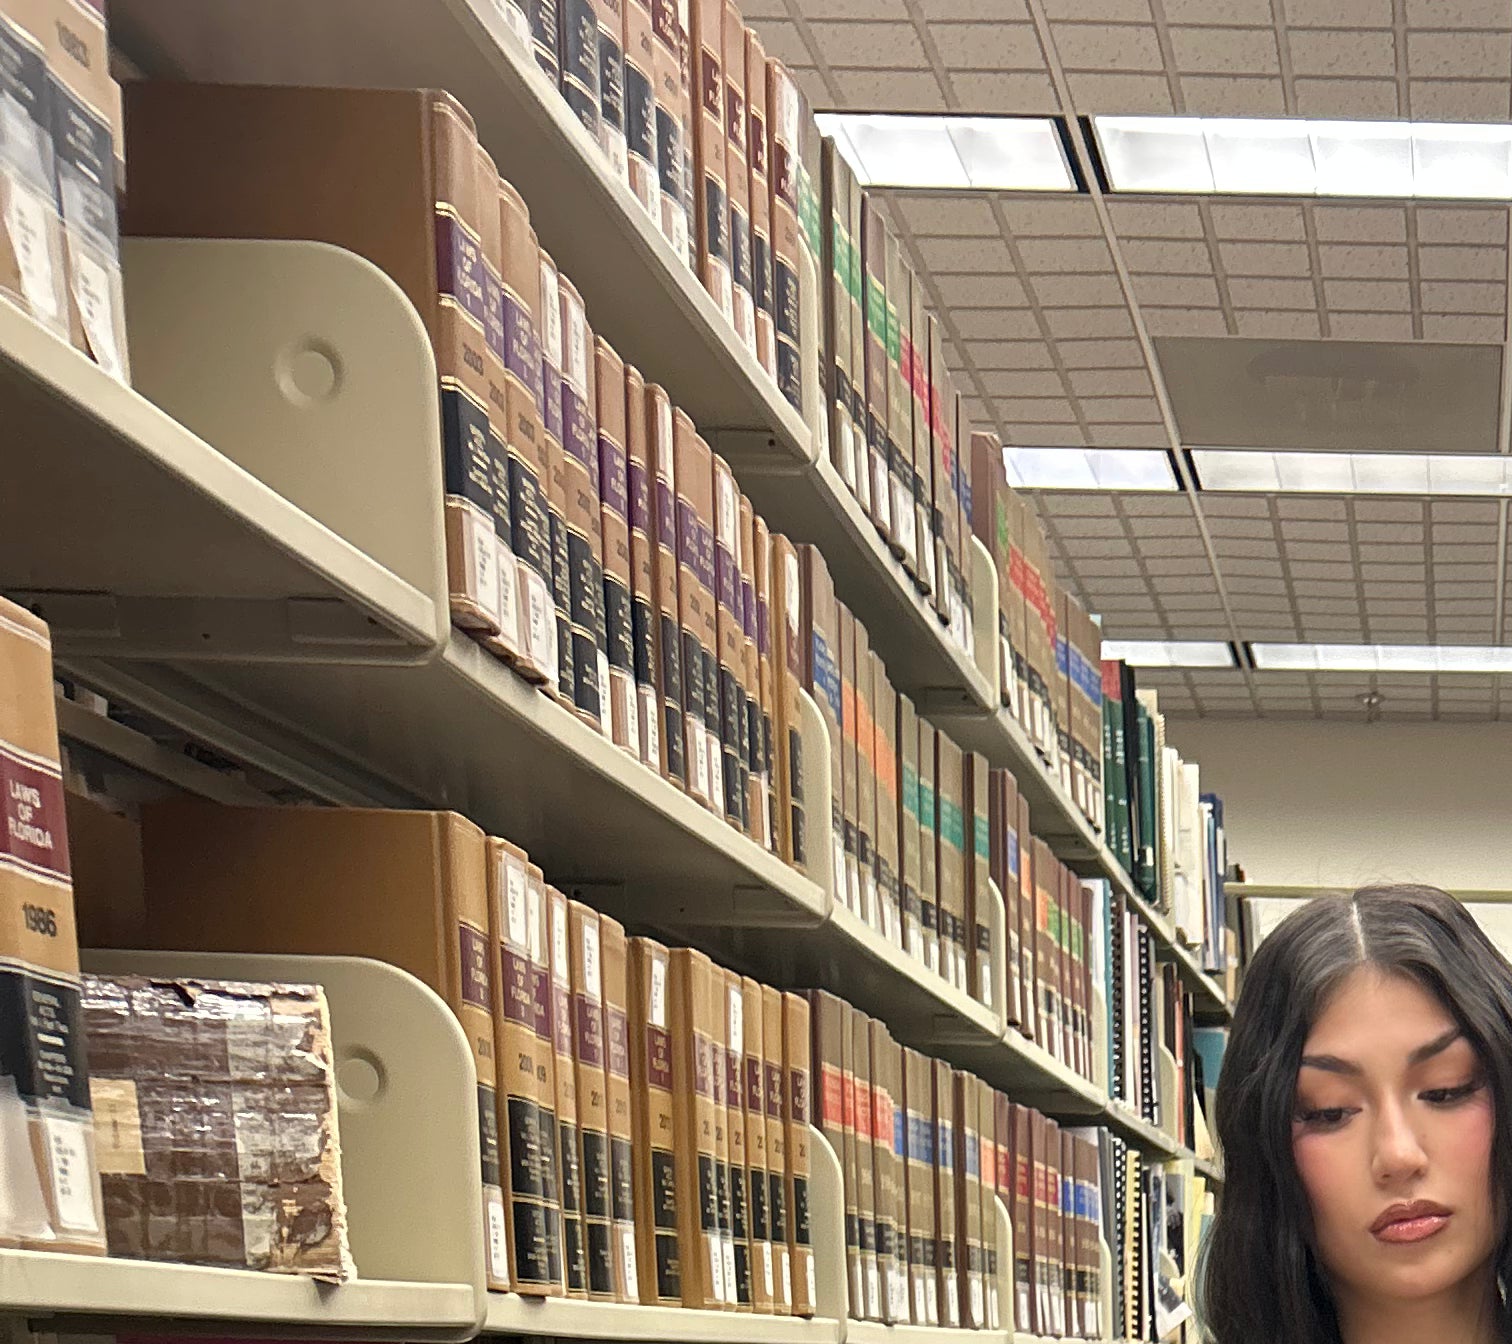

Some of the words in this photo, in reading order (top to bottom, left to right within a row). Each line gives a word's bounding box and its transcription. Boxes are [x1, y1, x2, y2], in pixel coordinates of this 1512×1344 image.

[8, 779, 41, 808] LAWS
[17, 806, 33, 823] OF
[8, 821, 53, 850] FLORIDA
[22, 902, 58, 938] 1986
